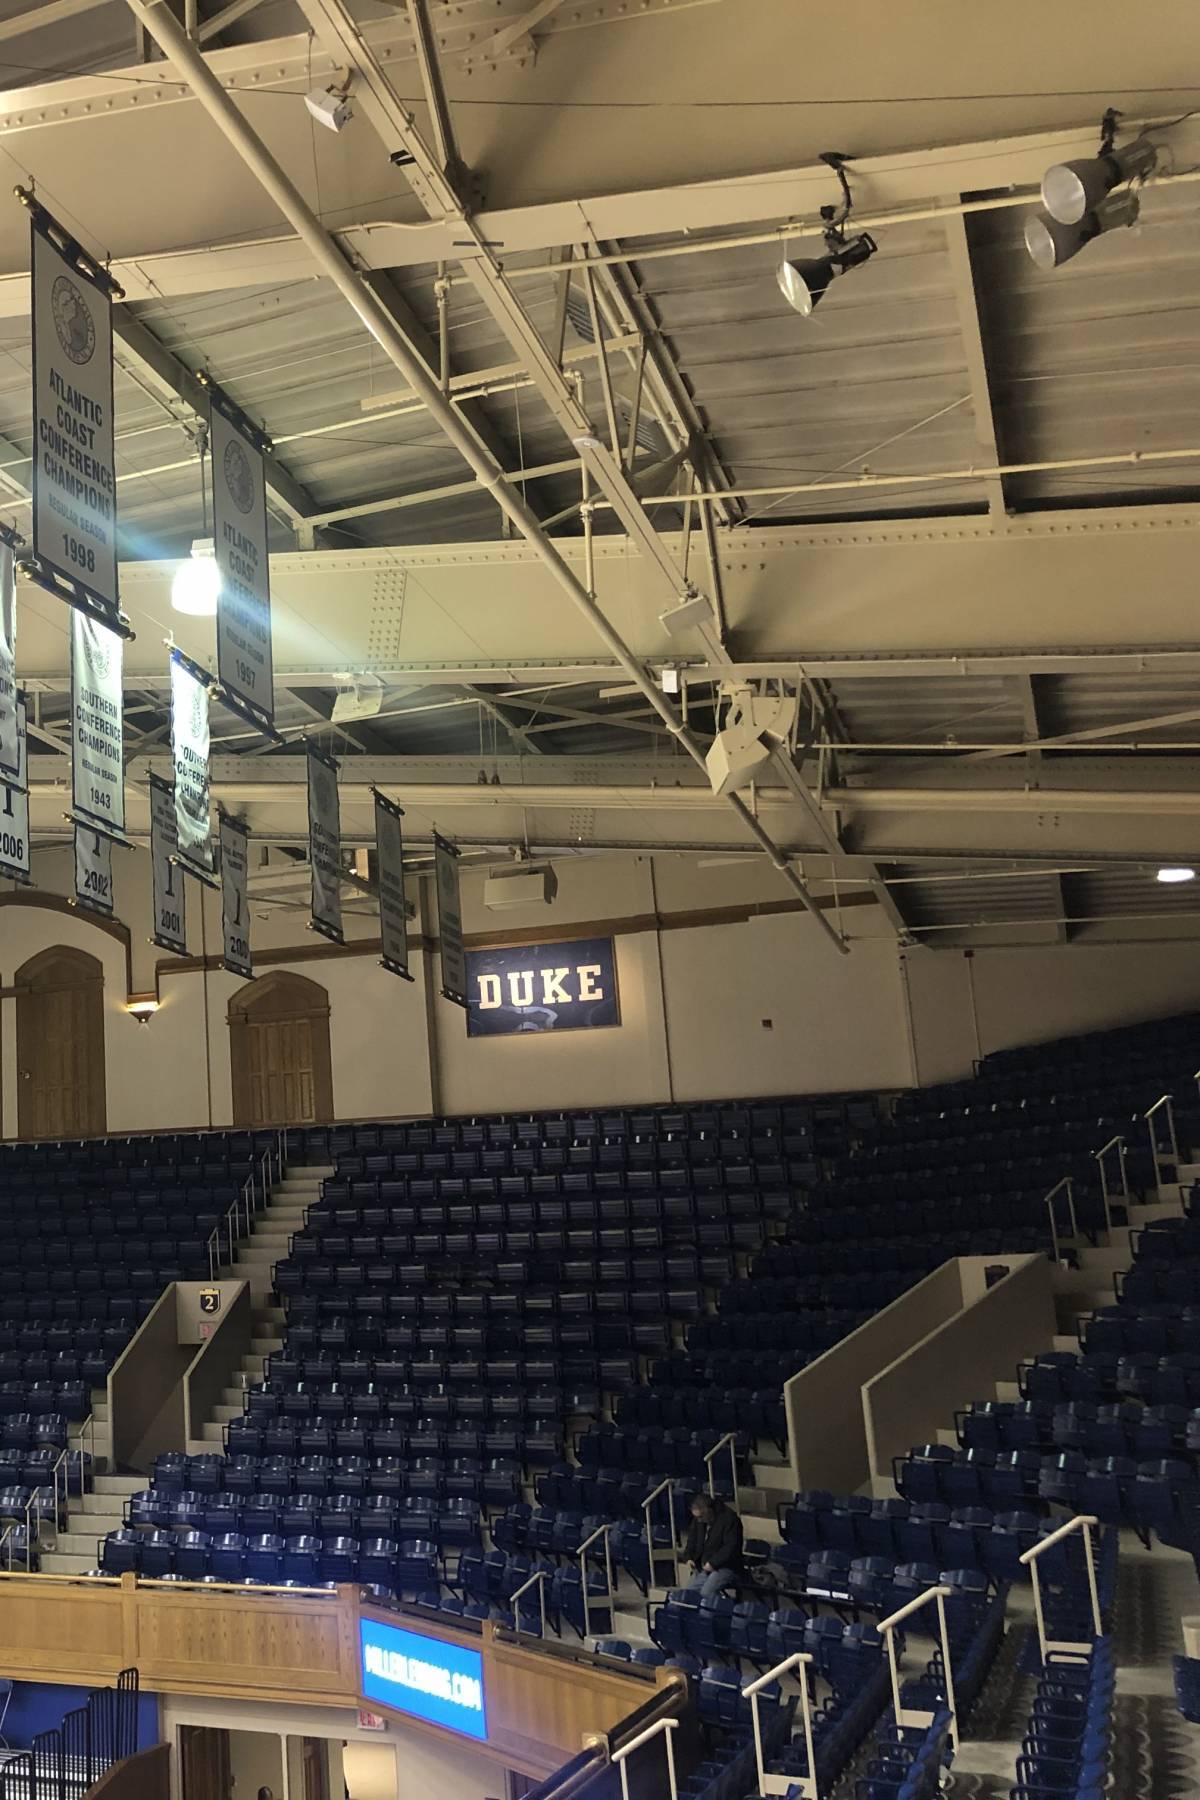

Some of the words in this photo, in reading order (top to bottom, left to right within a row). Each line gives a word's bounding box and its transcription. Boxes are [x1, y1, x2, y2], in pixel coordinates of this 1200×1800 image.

[49, 368, 103, 427] ATLANTIC
[57, 405, 95, 450] COAST
[40, 418, 113, 493] CONFERENCE
[44, 452, 111, 520] CHAMPIONS
[63, 534, 95, 573] 1998
[223, 521, 258, 567] ATLANTIC
[81, 687, 118, 719] SOUTHERN
[76, 705, 121, 742] CONFERENCE
[79, 727, 120, 763] CHAMPIONS
[90, 786, 111, 809] 1943
[84, 868, 108, 896] 2002
[161, 909, 179, 934] 2001
[477, 964, 603, 1010] DUKE
[205, 1295, 214, 1310] 2
